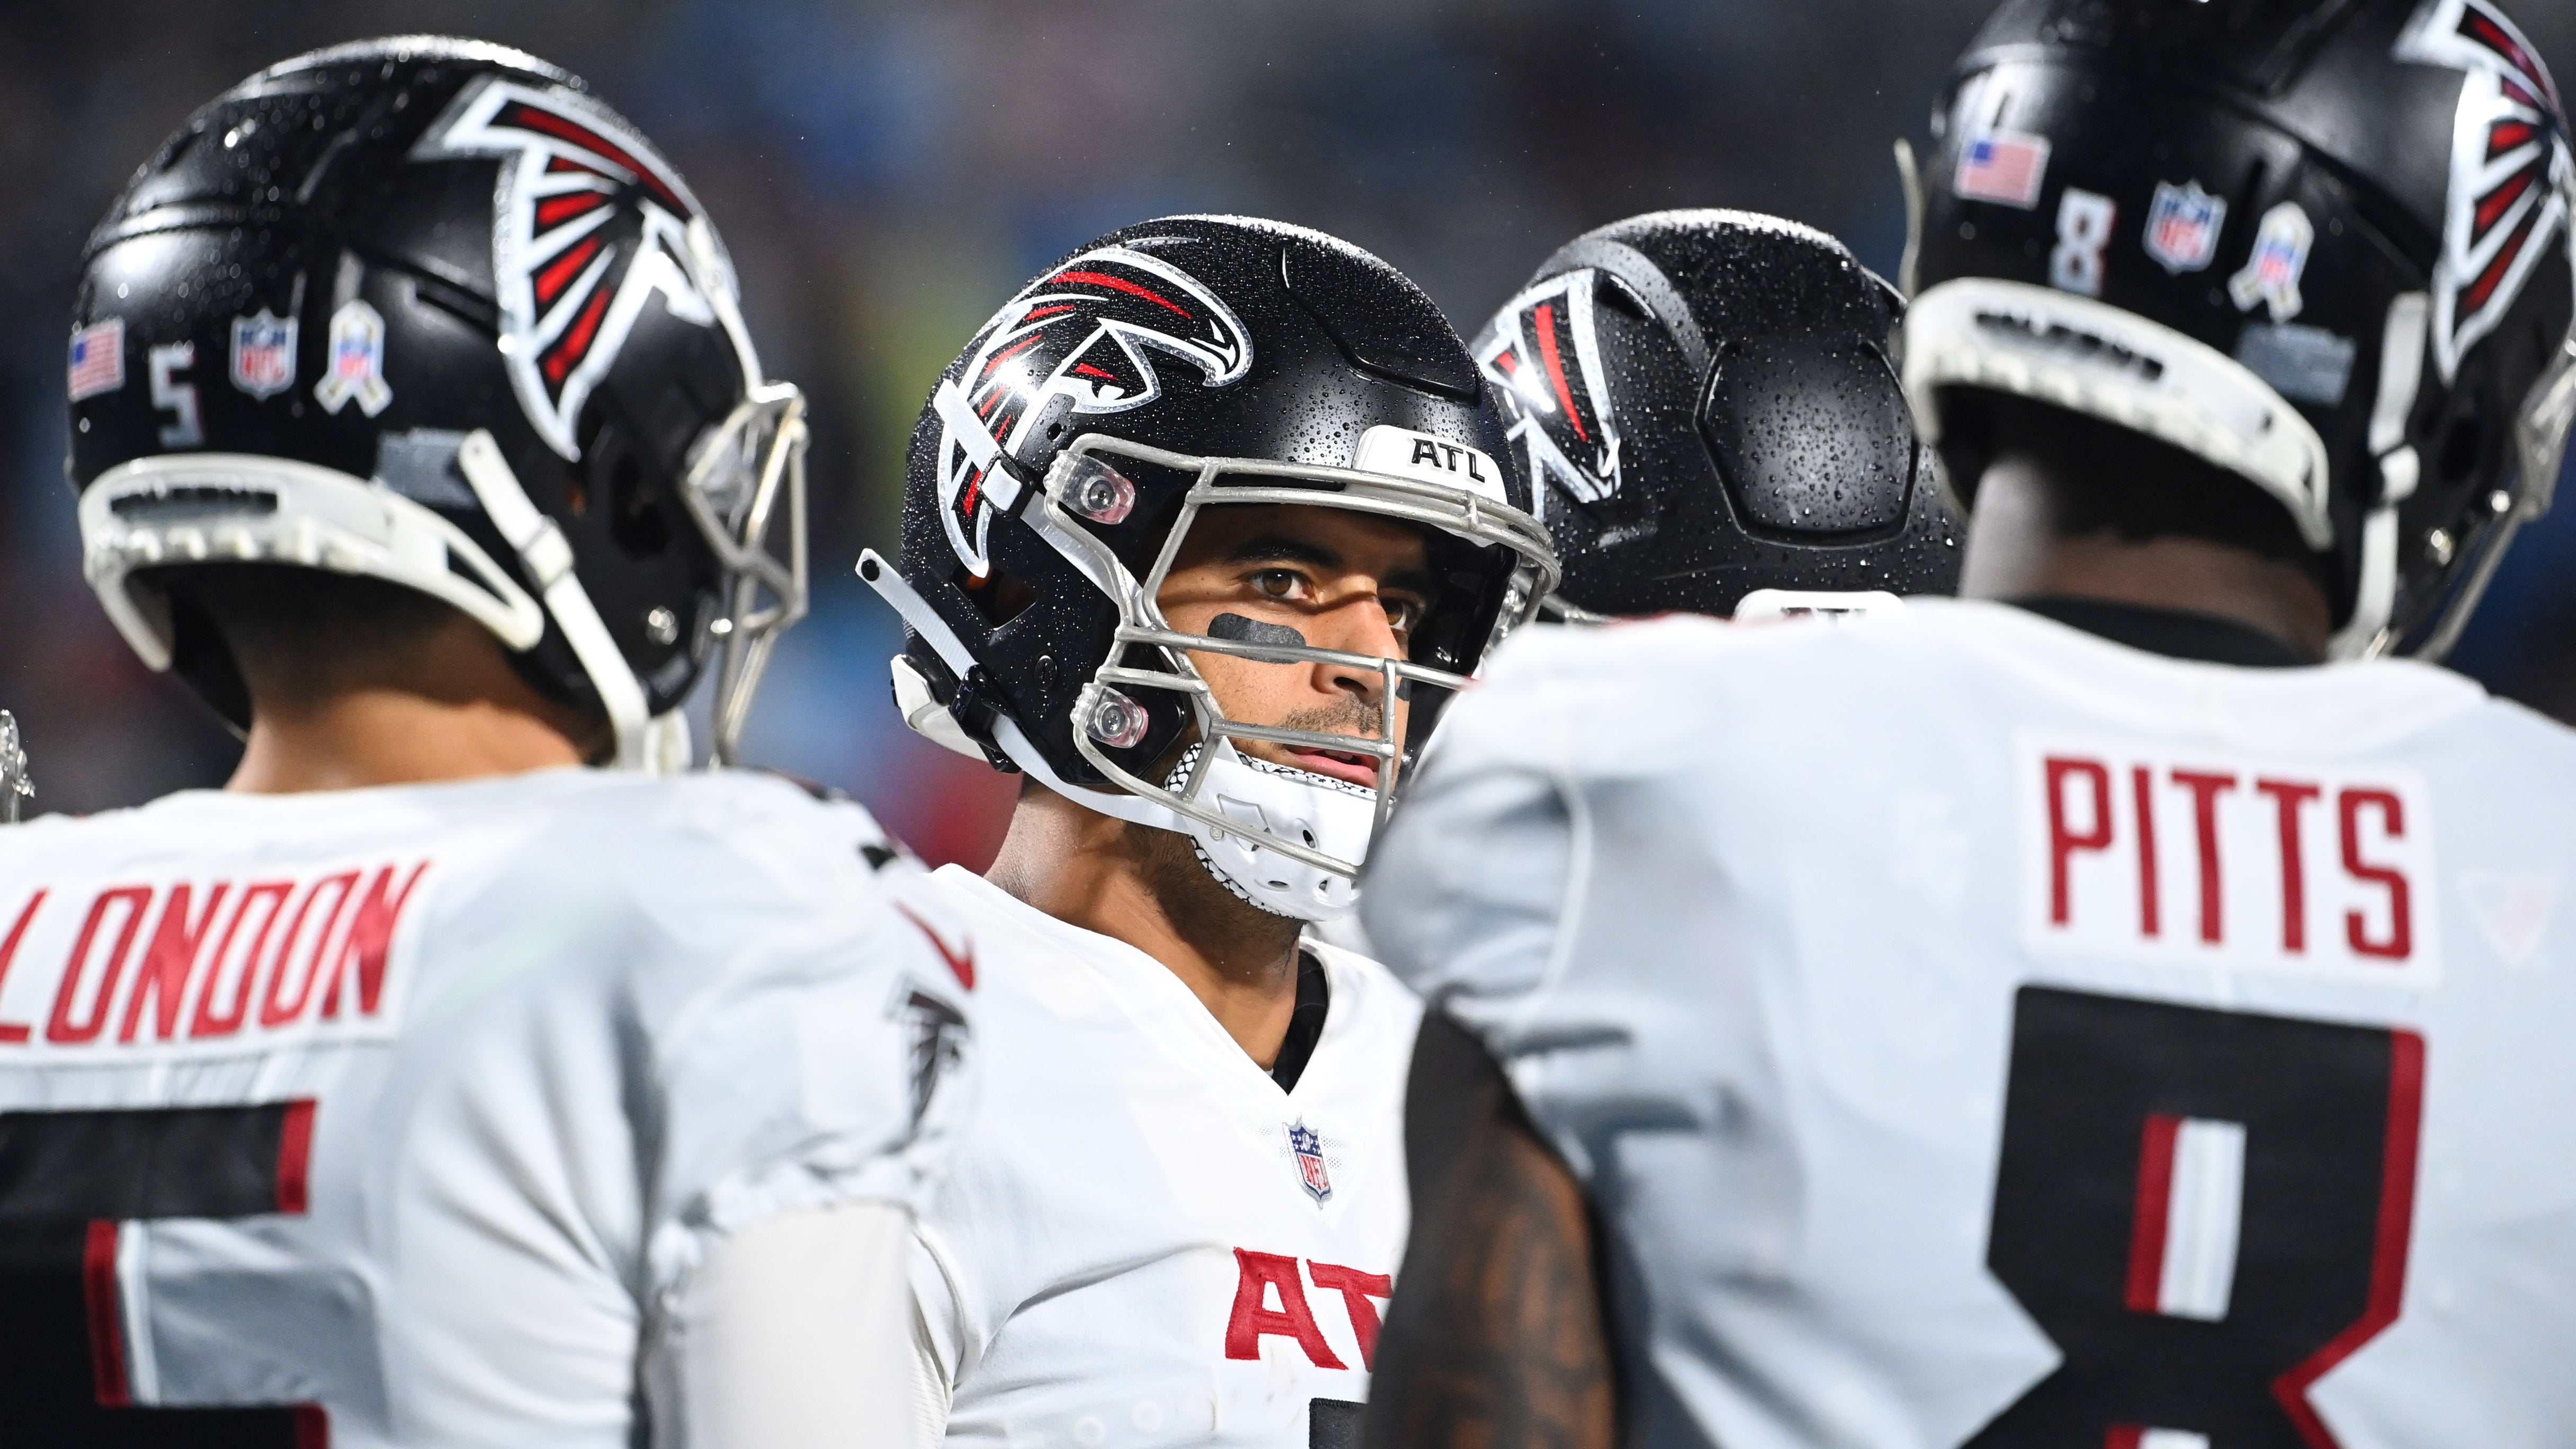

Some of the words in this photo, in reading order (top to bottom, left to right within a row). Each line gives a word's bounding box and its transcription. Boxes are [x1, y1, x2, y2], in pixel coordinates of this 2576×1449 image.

[2050, 186, 2117, 297] 8
[147, 341, 207, 448] 5
[1411, 439, 1485, 483] ATL
[2044, 756, 2413, 964] PITTS
[0, 858, 433, 1045] LONDON
[1299, 1153, 1330, 1191] NFL
